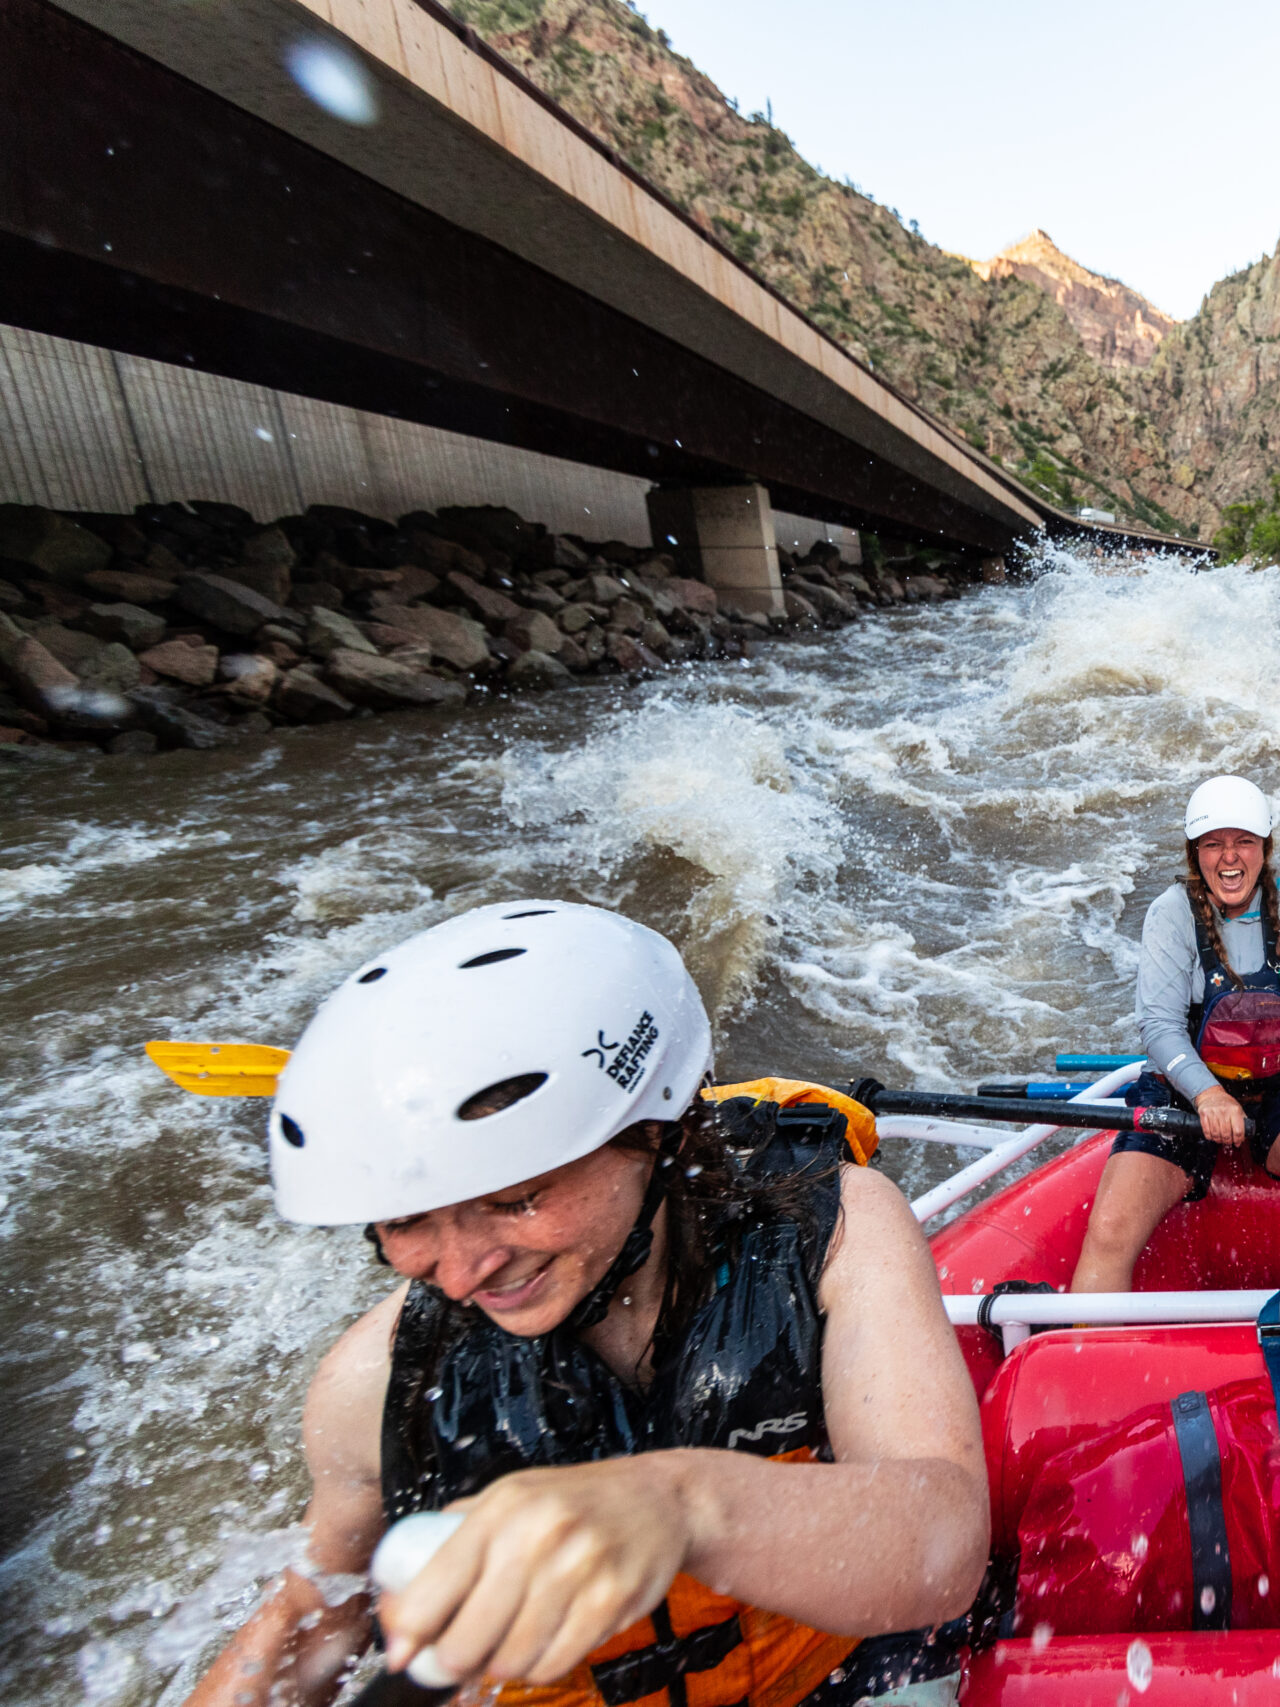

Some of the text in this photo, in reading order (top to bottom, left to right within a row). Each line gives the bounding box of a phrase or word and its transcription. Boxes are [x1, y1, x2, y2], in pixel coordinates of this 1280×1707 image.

[606, 1010, 654, 1080] DEFIANCE
[616, 1026, 659, 1089] RAFTING
[727, 1411, 808, 1449] NRS
